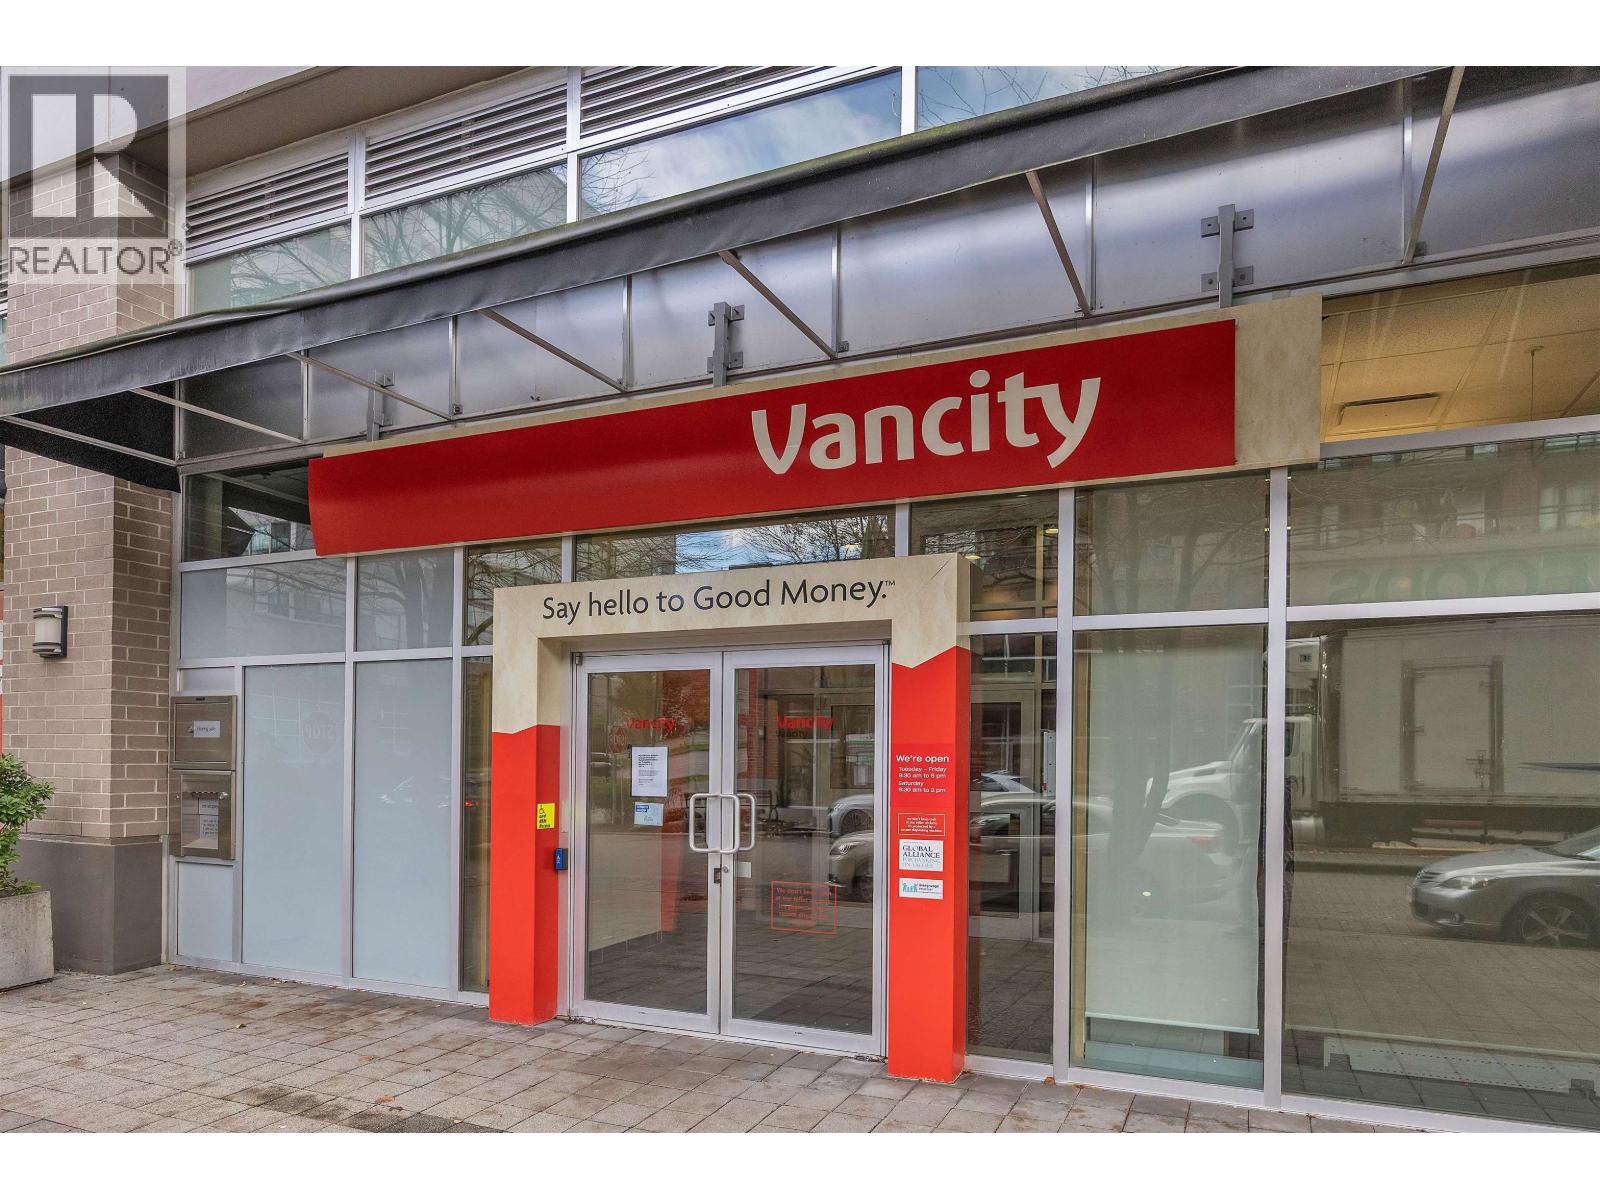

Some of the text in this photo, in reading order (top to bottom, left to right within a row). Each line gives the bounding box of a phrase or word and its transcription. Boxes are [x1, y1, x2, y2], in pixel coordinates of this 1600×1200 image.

[750, 369, 1102, 475] Vancity
[542, 597, 581, 625] Say
[588, 589, 649, 618] hello
[656, 592, 685, 613] to
[693, 579, 770, 611] Good
[896, 754, 949, 763] We're open
